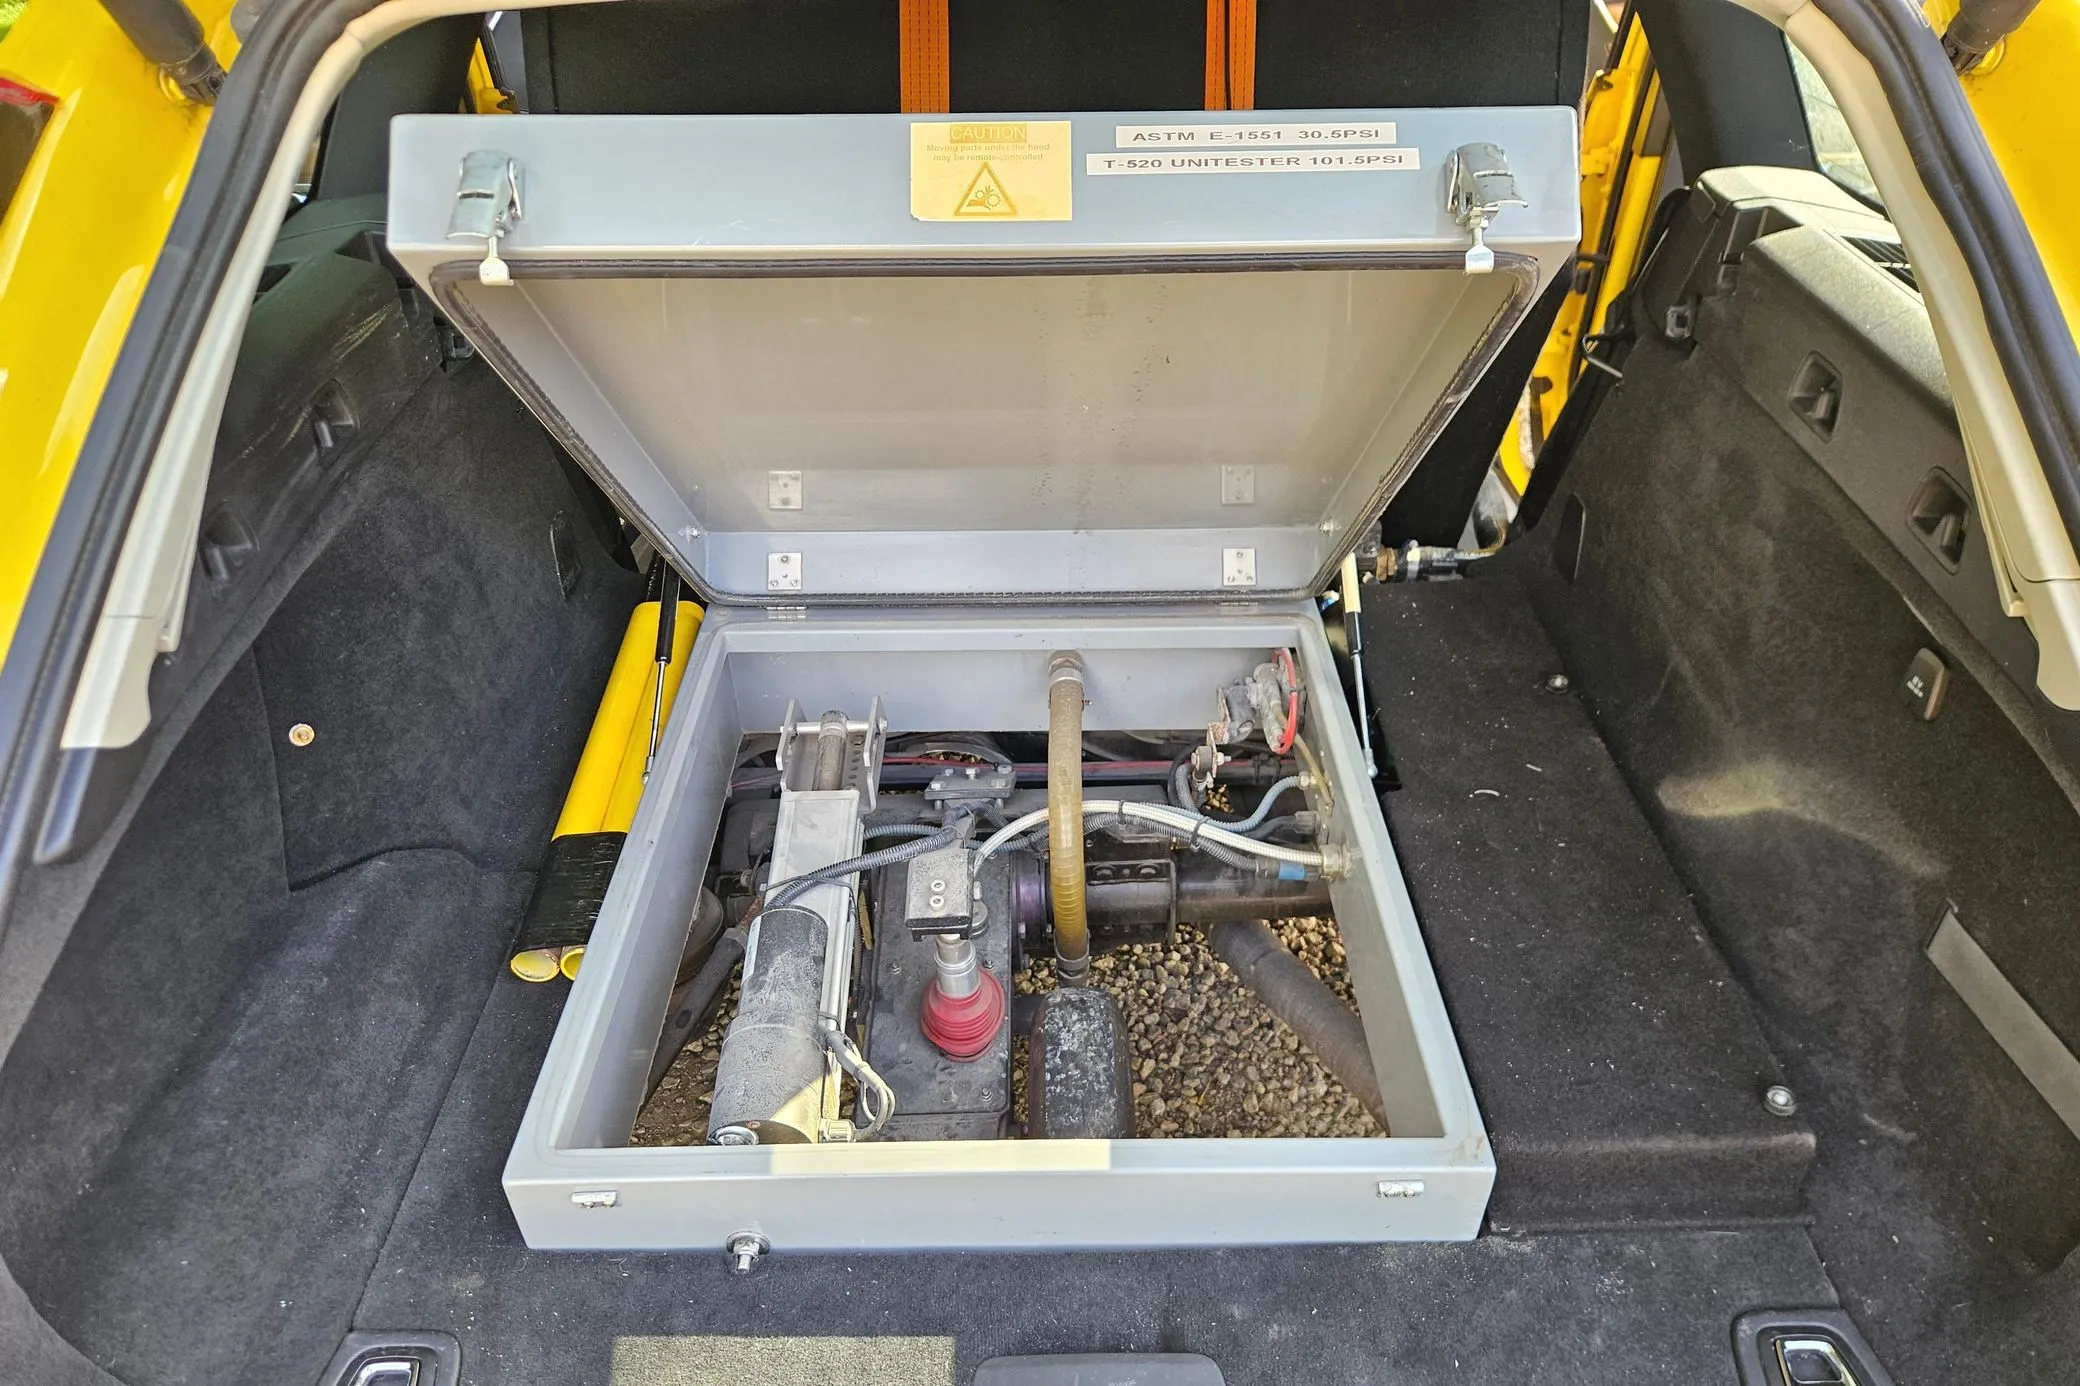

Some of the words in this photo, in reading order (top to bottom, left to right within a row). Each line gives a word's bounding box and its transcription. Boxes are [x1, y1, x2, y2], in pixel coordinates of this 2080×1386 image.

[950, 126, 1026, 140] CAUTION
[1132, 131, 1195, 142] ASTM
[1209, 130, 1282, 141] E-1551
[1298, 129, 1379, 140] 30.5PSI
[926, 144, 958, 153] Moving
[960, 144, 982, 153] parts
[984, 144, 1009, 152] under
[1012, 143, 1026, 151] the
[1028, 142, 1050, 151] hood
[933, 155, 951, 163] may
[954, 153, 965, 161] be
[967, 152, 1043, 161] remote-controlled
[1103, 158, 1163, 169] T-520
[1171, 156, 1301, 168] UNITESTER
[1309, 155, 1404, 166] 101.5PSI
